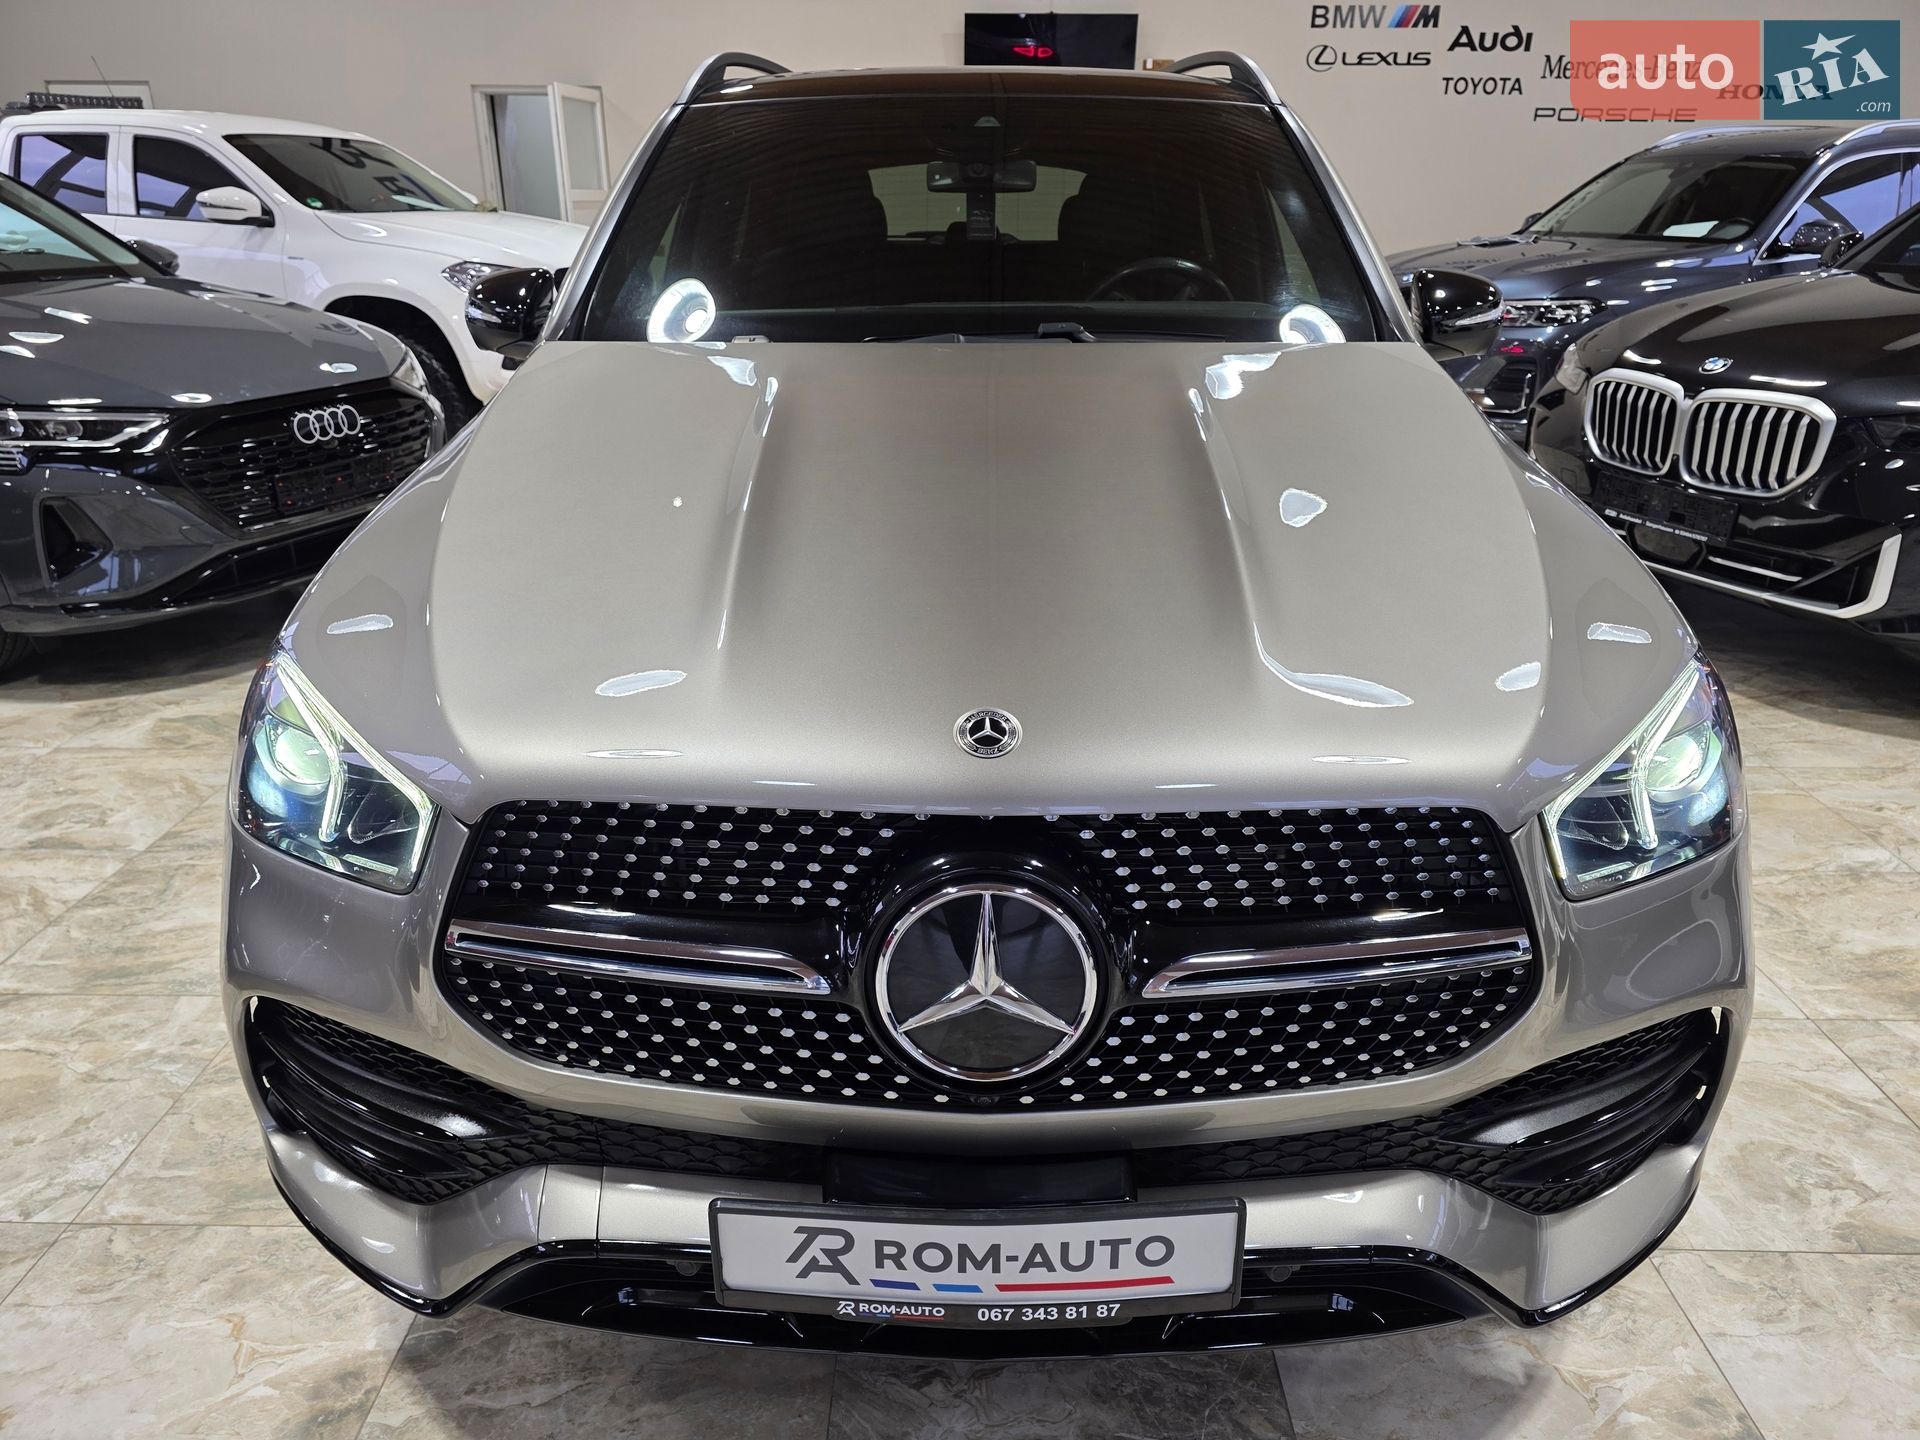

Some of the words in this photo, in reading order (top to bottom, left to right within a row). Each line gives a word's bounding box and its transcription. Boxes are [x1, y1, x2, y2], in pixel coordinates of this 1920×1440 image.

[1311, 5, 1387, 29] BMW
[1447, 25, 1534, 52] Audi
[1342, 52, 1432, 66] LEXUS
[1541, 54, 1703, 80] Mercee-Bez
[1442, 77, 1524, 96] TOYOTA
[1716, 84, 1833, 101] HONA
[1533, 107, 1698, 123] PORSCHE
[873, 1235, 1176, 1275] ROM-AUTO
[858, 1302, 946, 1317] ROM-AUTO
[977, 1308, 1015, 1322] 067
[1021, 1307, 1059, 1321] 343
[1065, 1305, 1089, 1319] 81
[1096, 1303, 1121, 1318] 87
